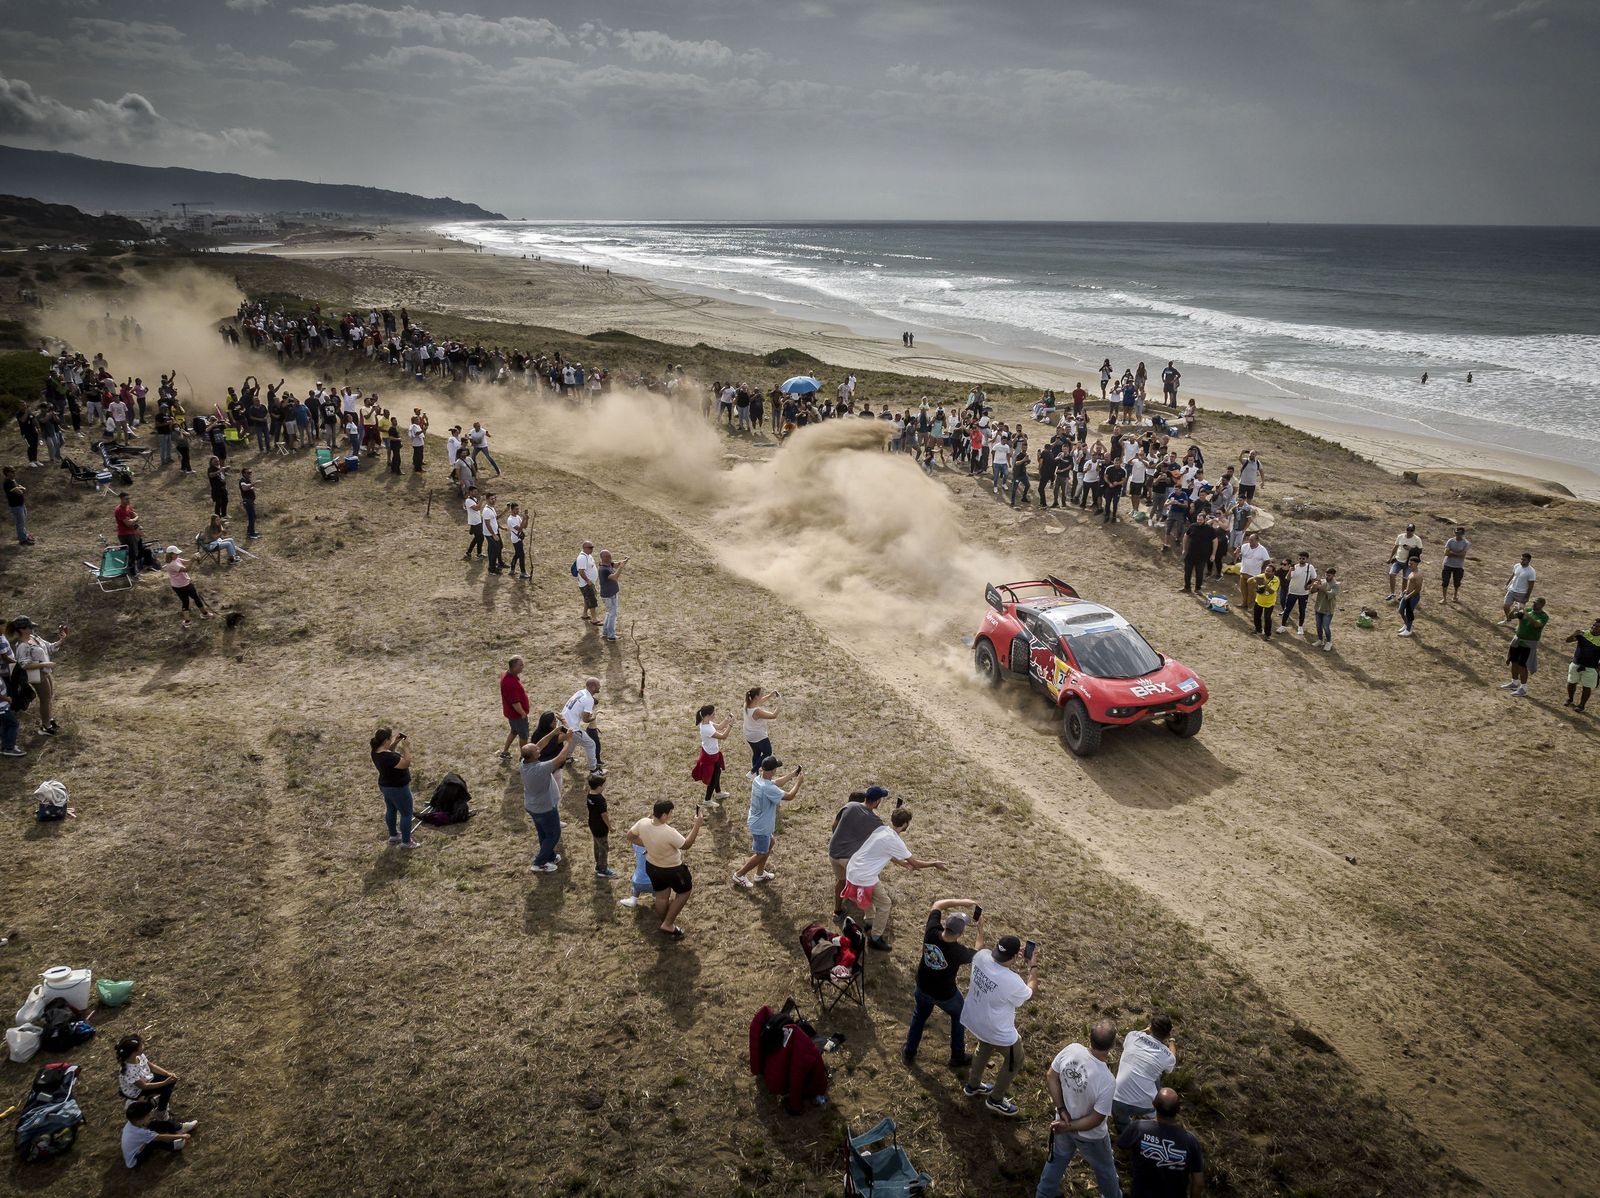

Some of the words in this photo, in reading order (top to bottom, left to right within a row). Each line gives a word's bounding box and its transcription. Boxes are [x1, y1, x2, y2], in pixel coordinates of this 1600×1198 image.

[1129, 682, 1172, 697] BRX
[974, 965, 998, 988] RESPECT
[1143, 1133, 1160, 1144] 1985
